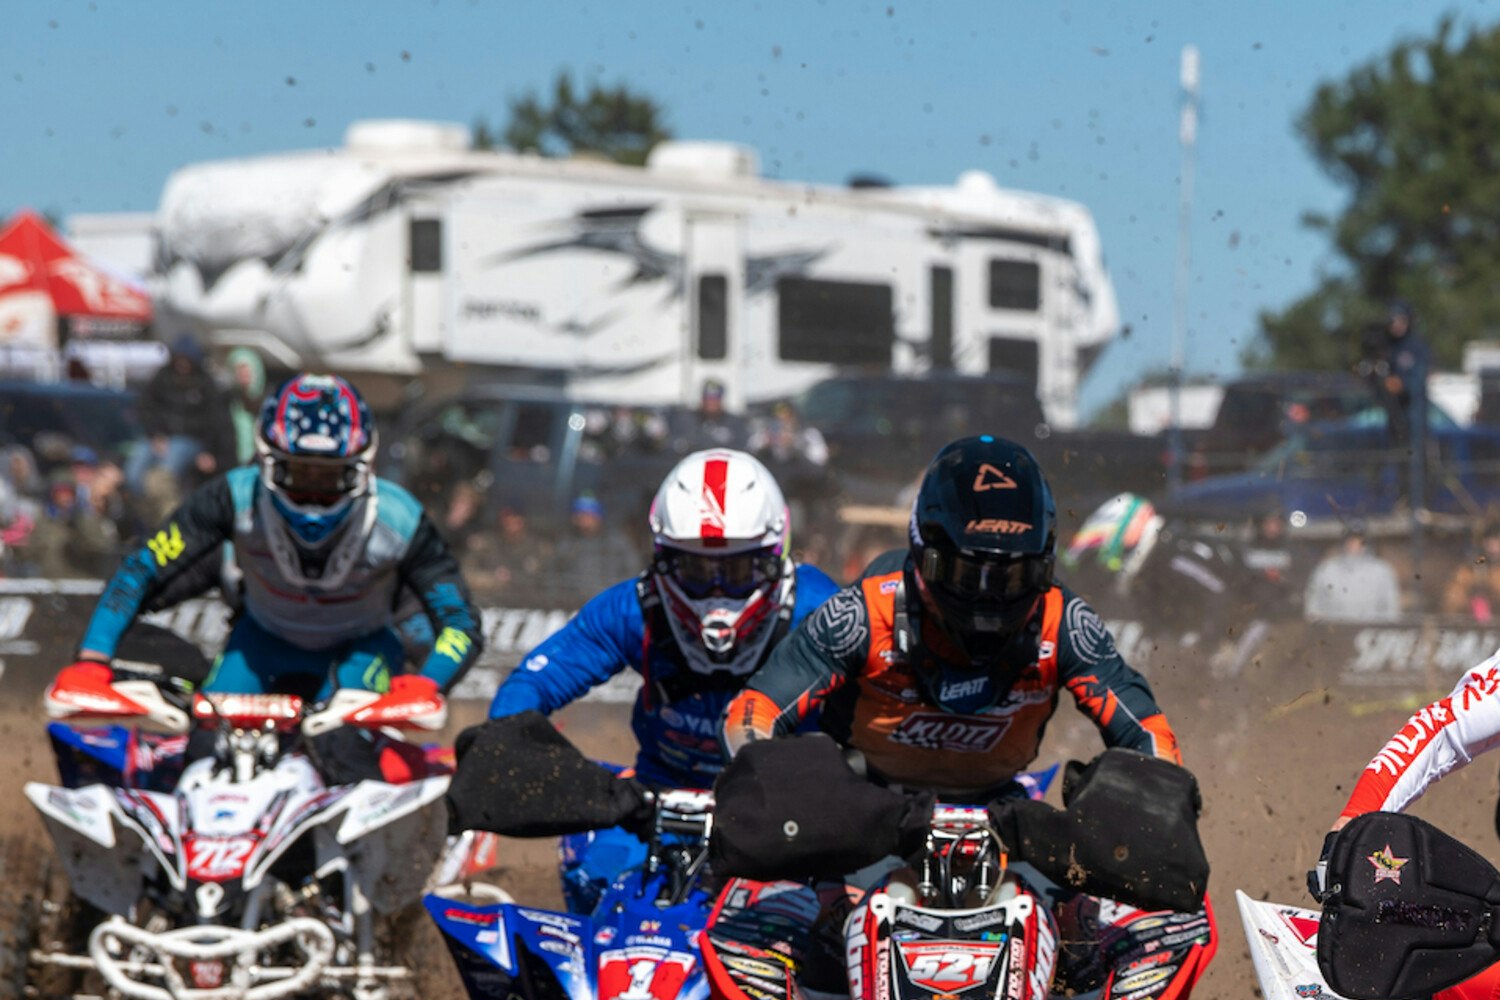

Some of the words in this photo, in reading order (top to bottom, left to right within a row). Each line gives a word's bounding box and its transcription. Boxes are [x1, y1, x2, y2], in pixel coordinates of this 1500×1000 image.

[964, 518, 1033, 535] LEATT
[940, 677, 989, 701] LEATT
[908, 721, 998, 745] KLOTZ
[189, 839, 253, 870] 712
[908, 953, 993, 982] 521
